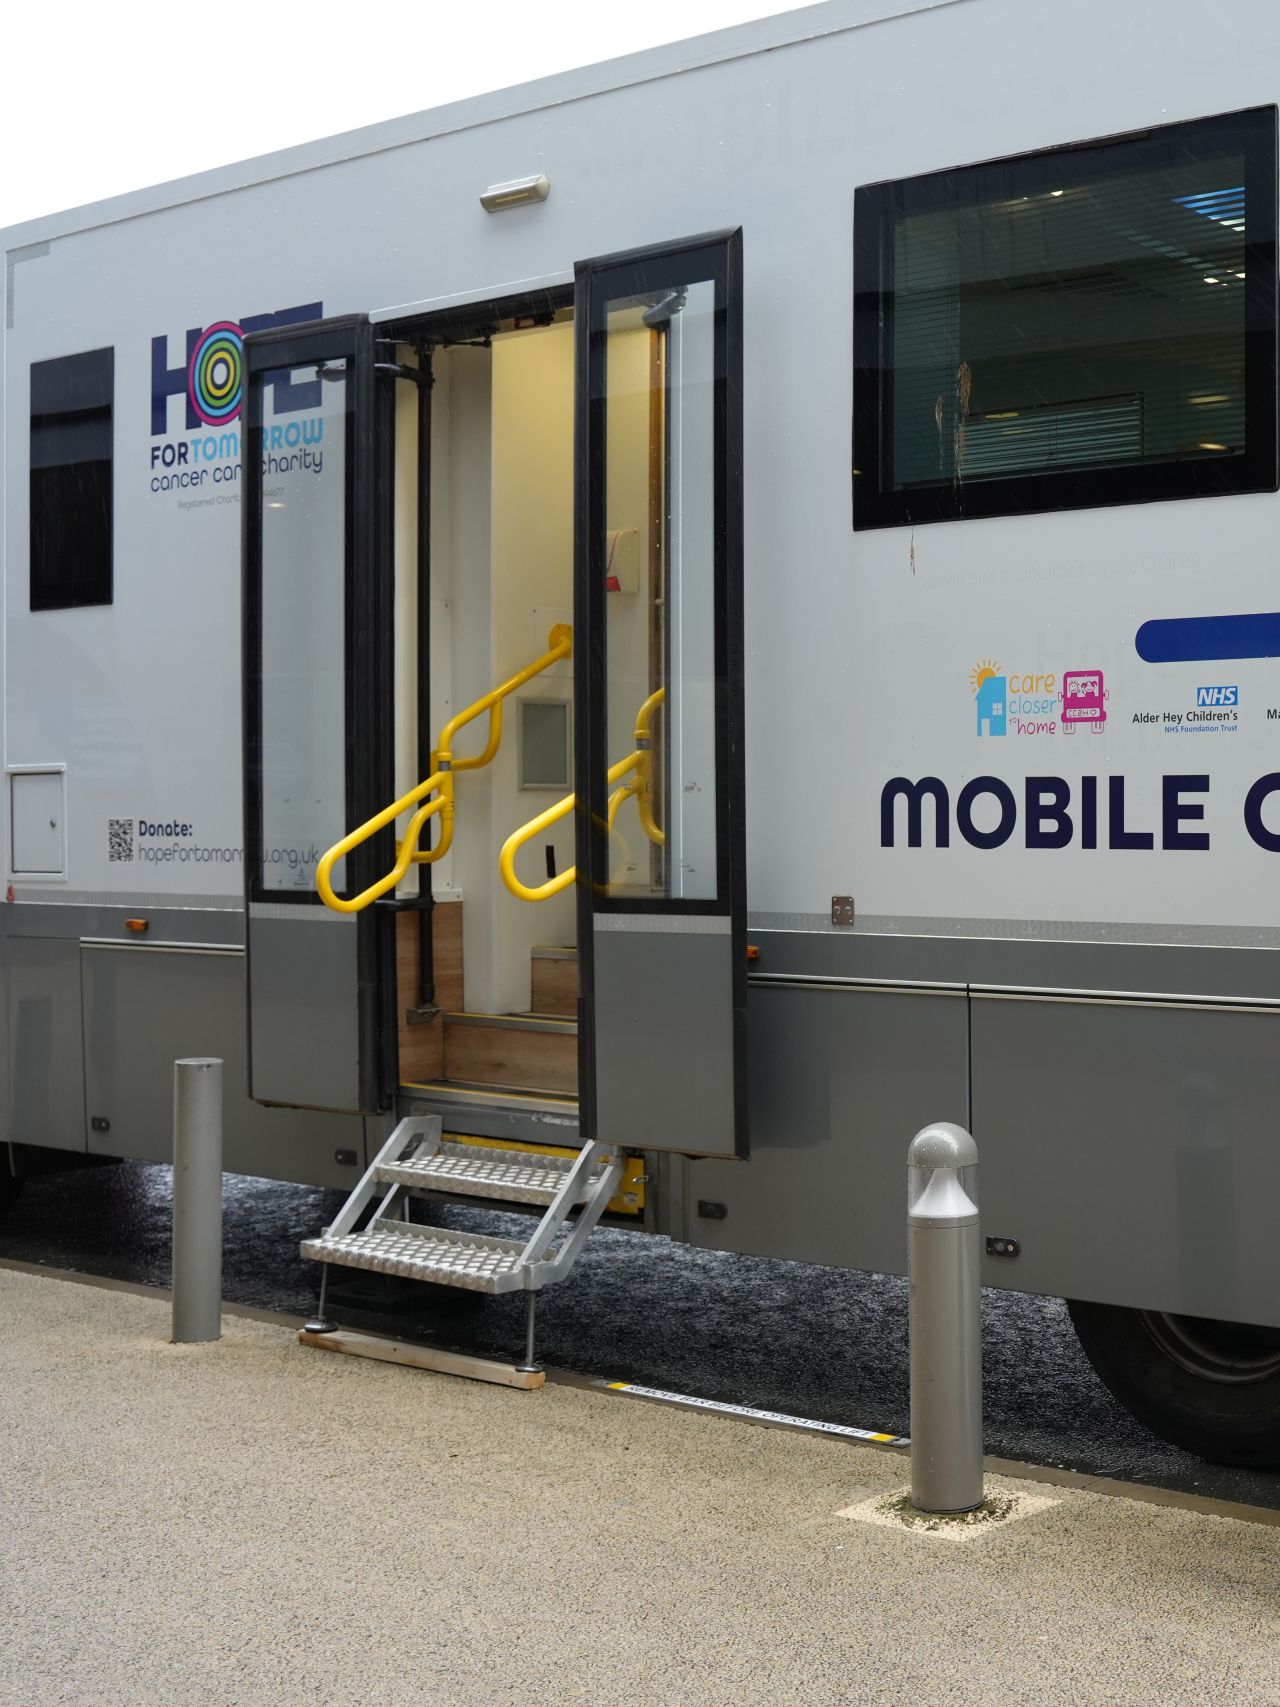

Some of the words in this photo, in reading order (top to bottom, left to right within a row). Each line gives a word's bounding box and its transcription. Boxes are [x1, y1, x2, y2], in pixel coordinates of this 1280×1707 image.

[151, 470, 209, 492] cancer
[213, 465, 242, 483] car
[1009, 673, 1056, 694] care
[1197, 687, 1238, 705] NHS
[1009, 698, 1057, 714] closer
[1017, 717, 1057, 736] home
[1132, 713, 1159, 724] Alder
[1163, 712, 1182, 725] Hey
[1186, 710, 1238, 723] Children's
[1164, 726, 1179, 734] NHS
[1181, 725, 1219, 733] Foundation
[1221, 724, 1238, 732] Trust
[880, 774, 1210, 850] MOBILE
[139, 820, 193, 837] Donate:
[763, 1411, 840, 1430] OPERATING
[840, 1426, 874, 1437] LIFT
